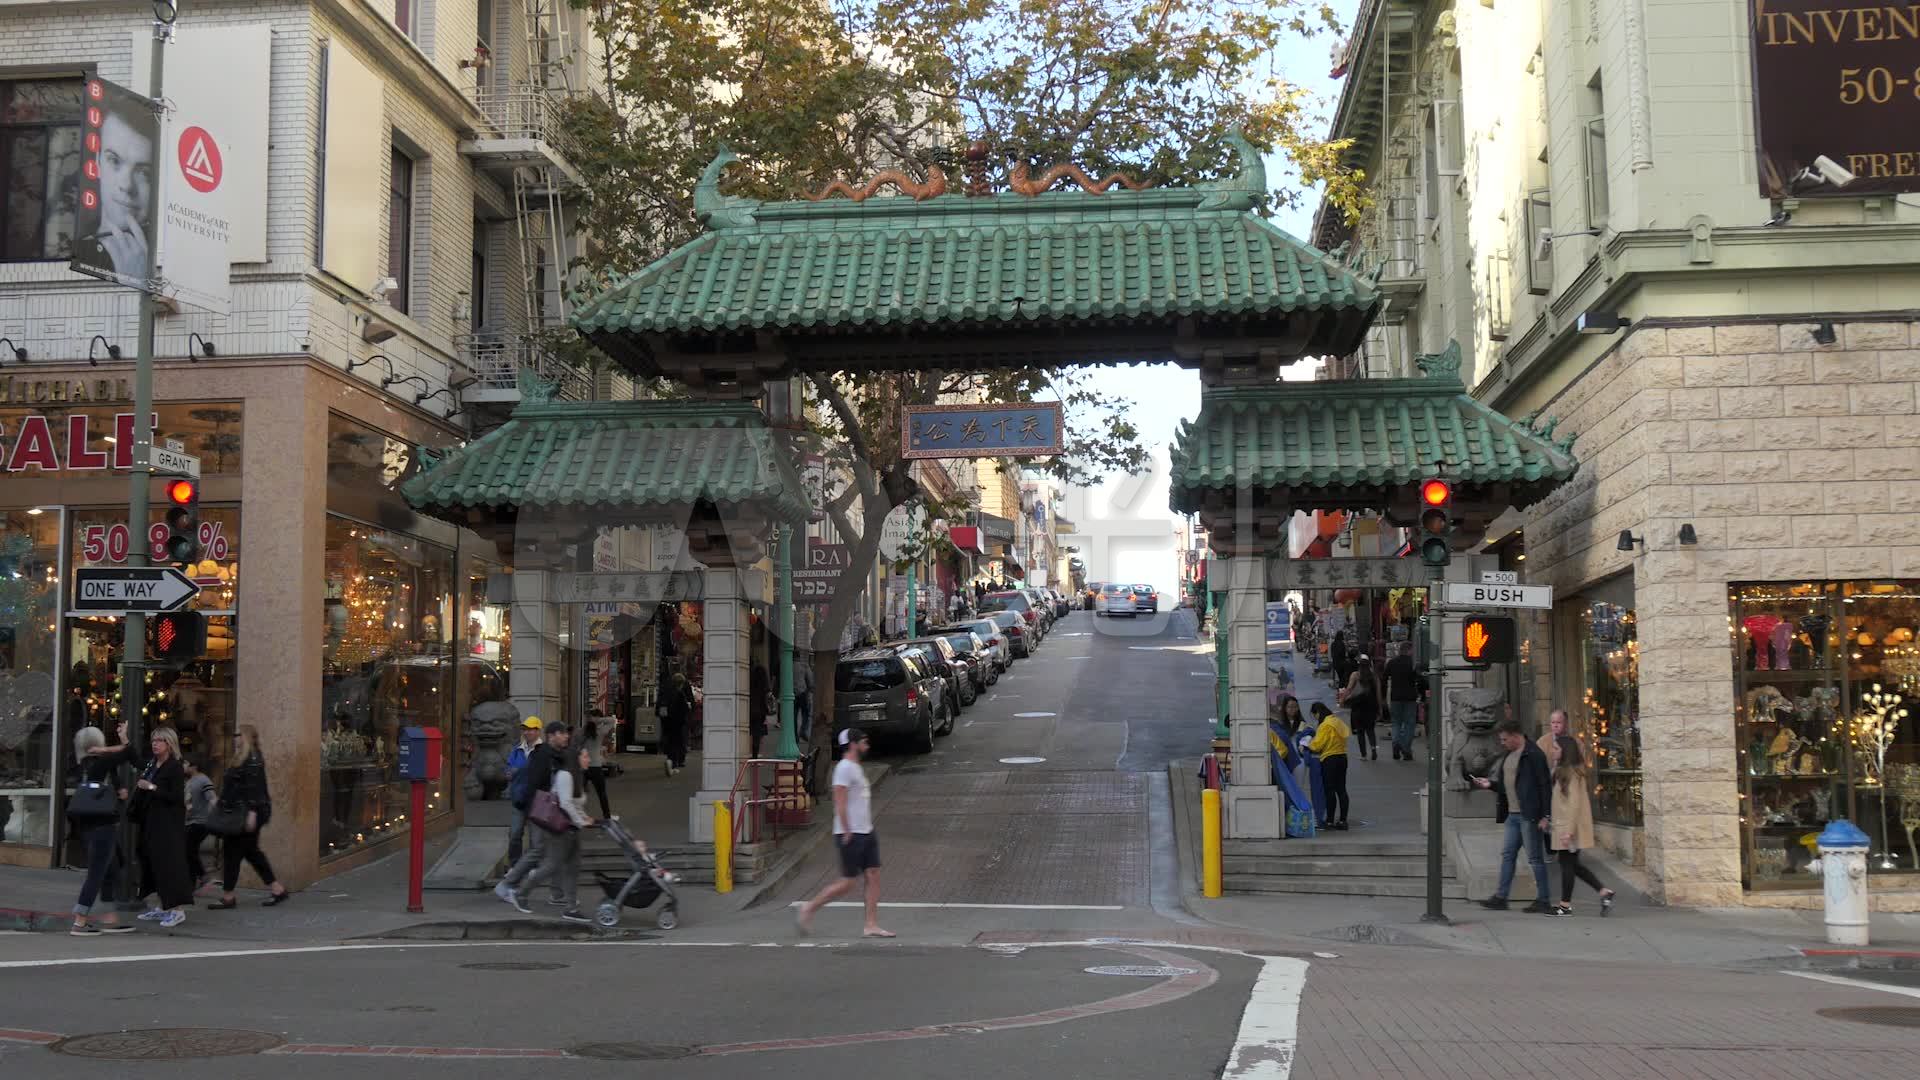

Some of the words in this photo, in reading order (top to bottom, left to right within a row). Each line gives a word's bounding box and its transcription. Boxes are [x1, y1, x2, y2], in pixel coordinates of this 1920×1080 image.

[1839, 66, 1920, 104] 50-
[86, 83, 101, 207] BUILD
[1846, 152, 1920, 178] FRE
[167, 202, 206, 223] ACADEMY
[167, 214, 230, 244] UNIVERSITY
[0, 412, 158, 472] ALE
[158, 453, 191, 471] GRANT
[793, 569, 841, 577] RESTAURANT
[1495, 573, 1514, 582] 500
[85, 582, 116, 598] ONE
[124, 582, 156, 598] WAY
[1474, 588, 1524, 602] BUSH
[584, 601, 617, 613] ATM
